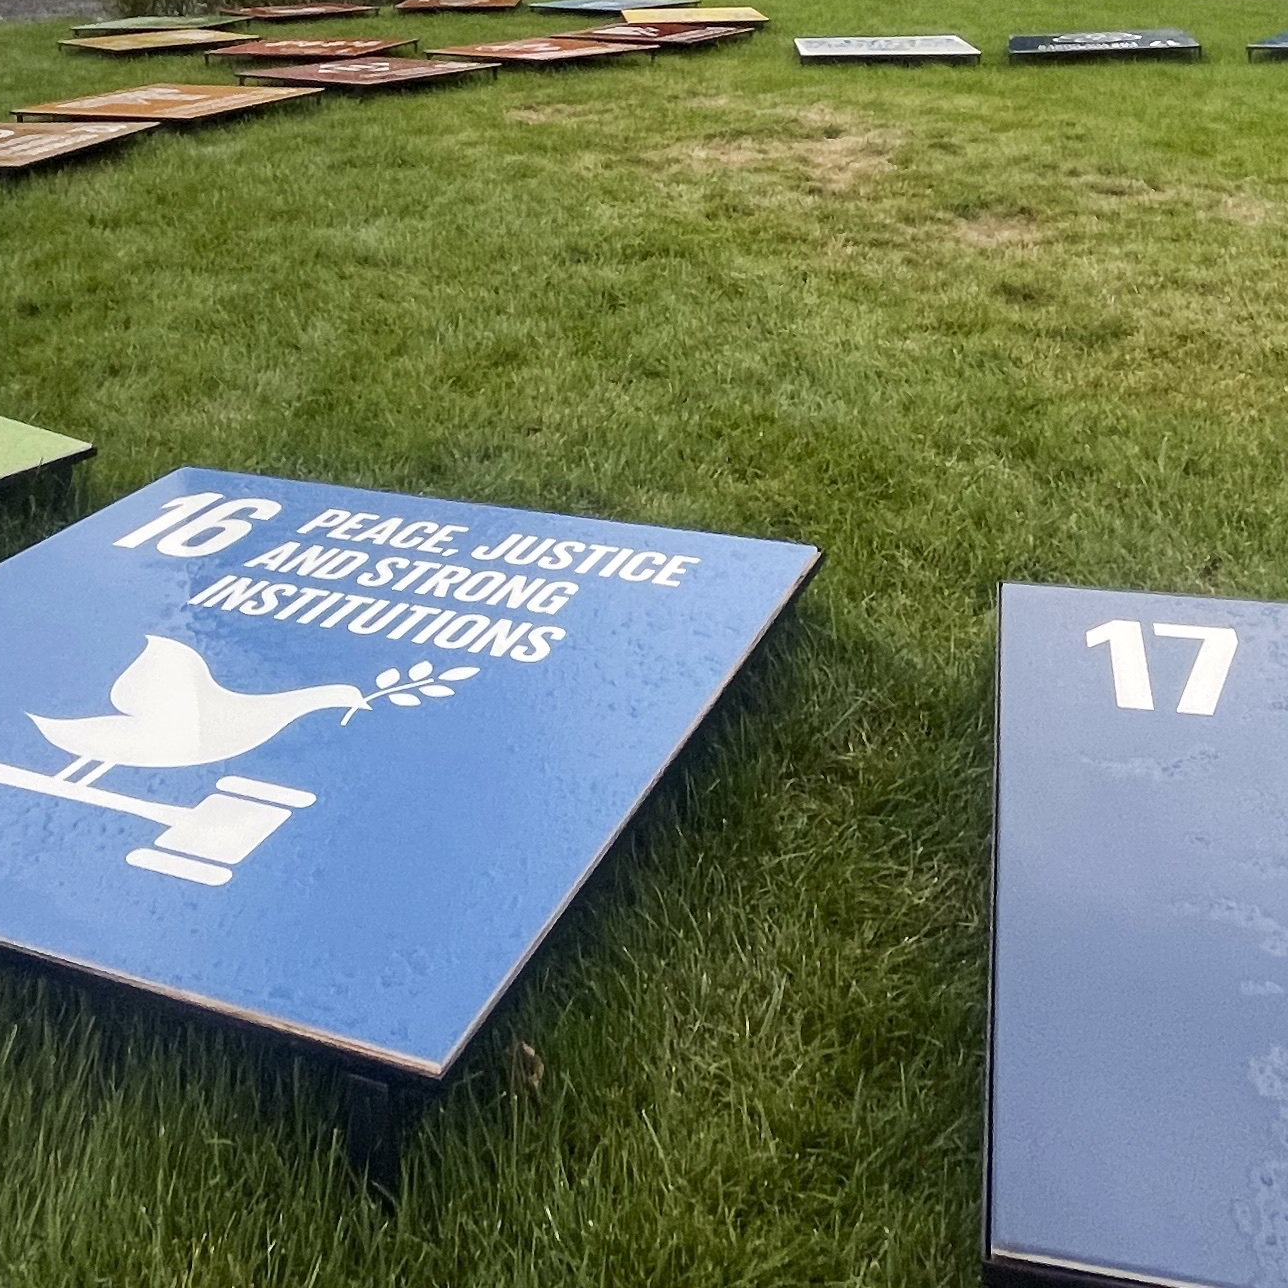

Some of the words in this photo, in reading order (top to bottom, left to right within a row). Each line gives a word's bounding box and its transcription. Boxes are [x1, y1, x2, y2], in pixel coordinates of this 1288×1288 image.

[112, 491, 283, 559] 16
[296, 508, 470, 557] PEACE,
[472, 533, 702, 589] JUSTICE
[243, 540, 365, 580] AND
[356, 556, 580, 616] STRONG
[187, 574, 567, 664] INSTITUTIONS
[1085, 618, 1240, 717] 17
